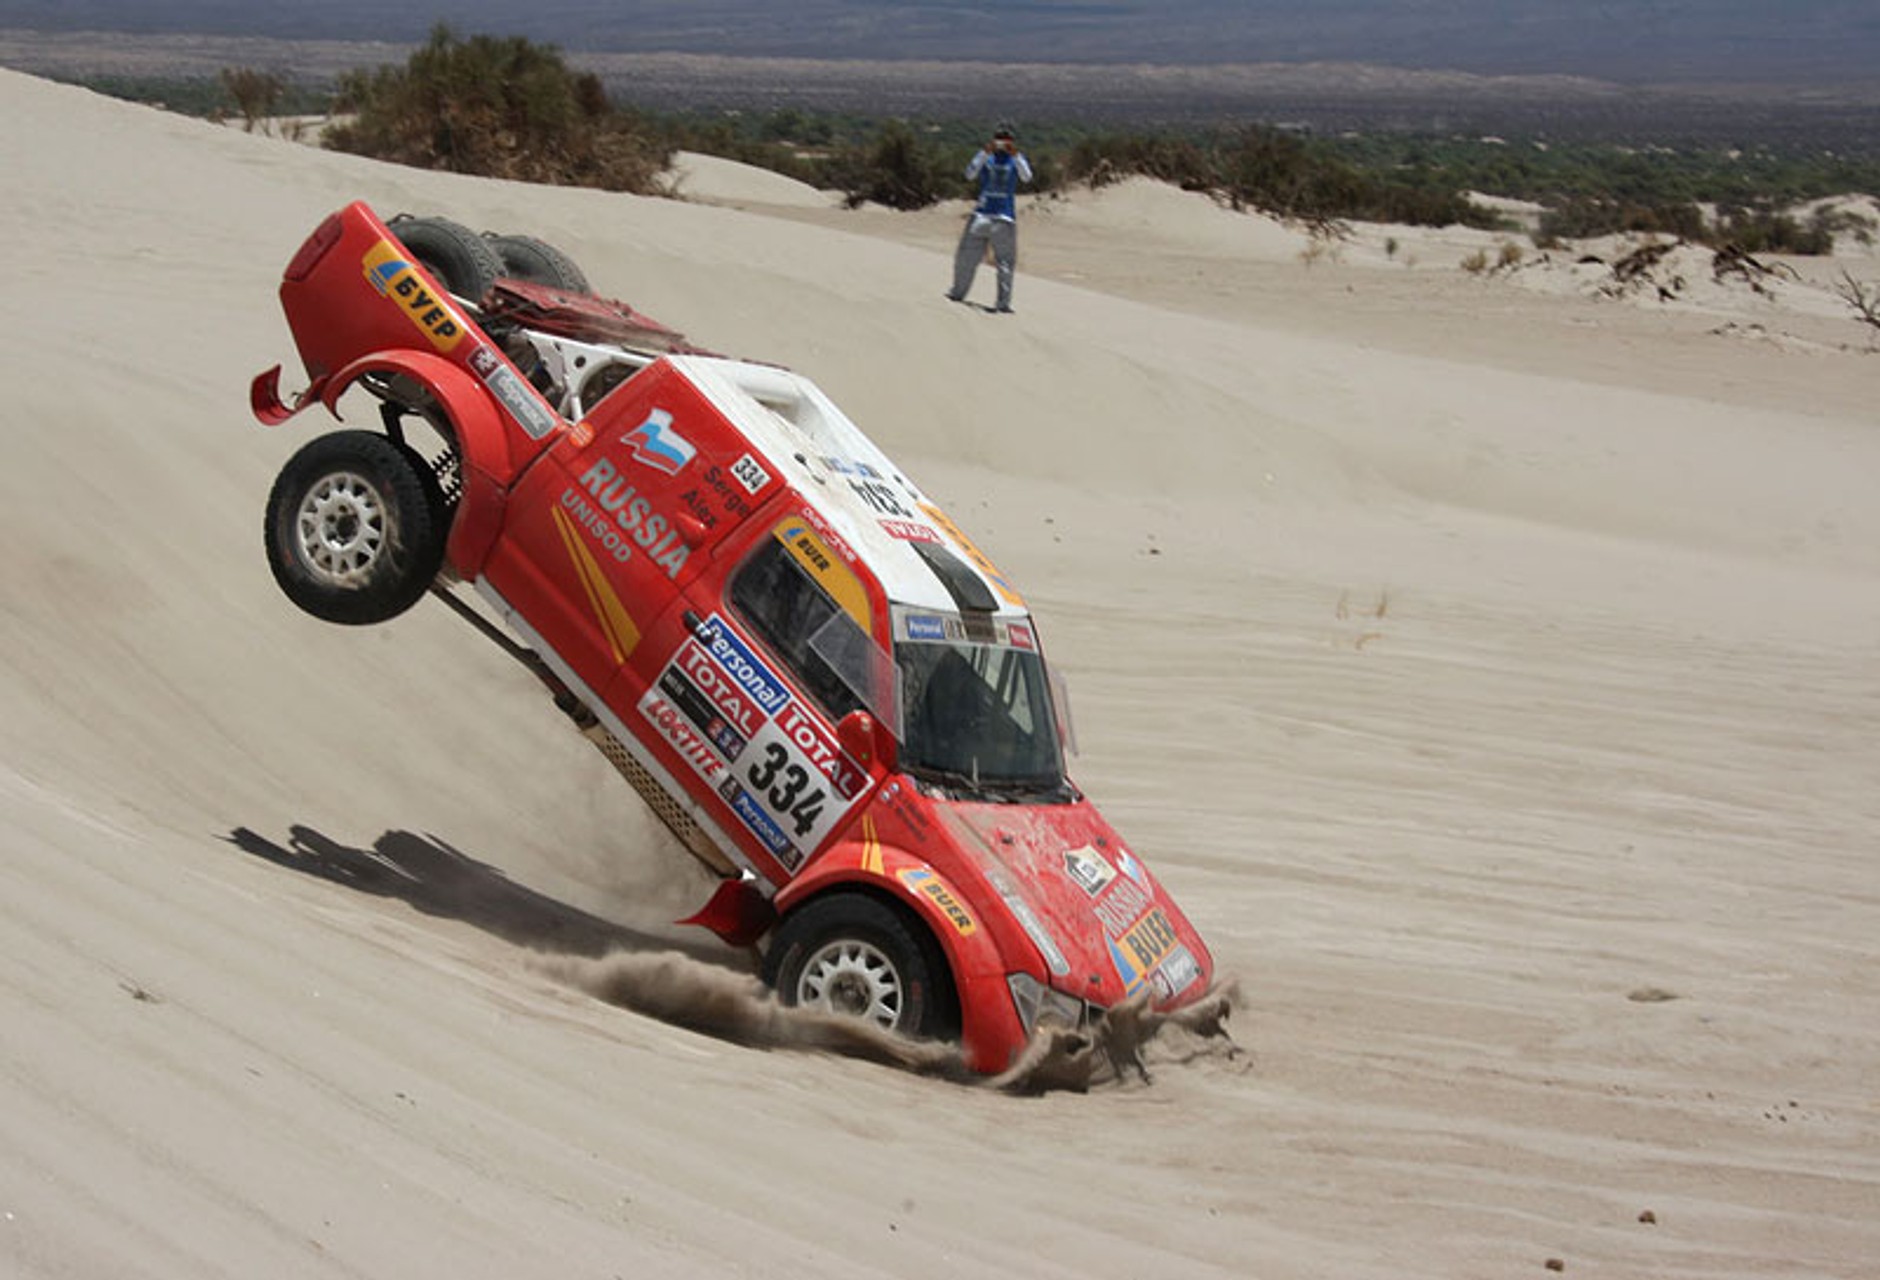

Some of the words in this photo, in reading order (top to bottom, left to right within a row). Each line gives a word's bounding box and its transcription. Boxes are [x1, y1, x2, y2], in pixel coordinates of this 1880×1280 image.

[395, 275, 457, 337] БУЕР
[734, 458, 764, 490] 334
[562, 488, 631, 562] UNISOD
[580, 458, 691, 579] RUSSIA
[796, 538, 830, 572] BUER
[686, 645, 752, 735] TOTAL
[647, 699, 723, 777] LOCTITE
[784, 705, 852, 796] TOTAL
[737, 795, 786, 848] Personal
[748, 742, 826, 837] 334
[925, 883, 971, 929] BUER
[1126, 910, 1176, 968] BUER
